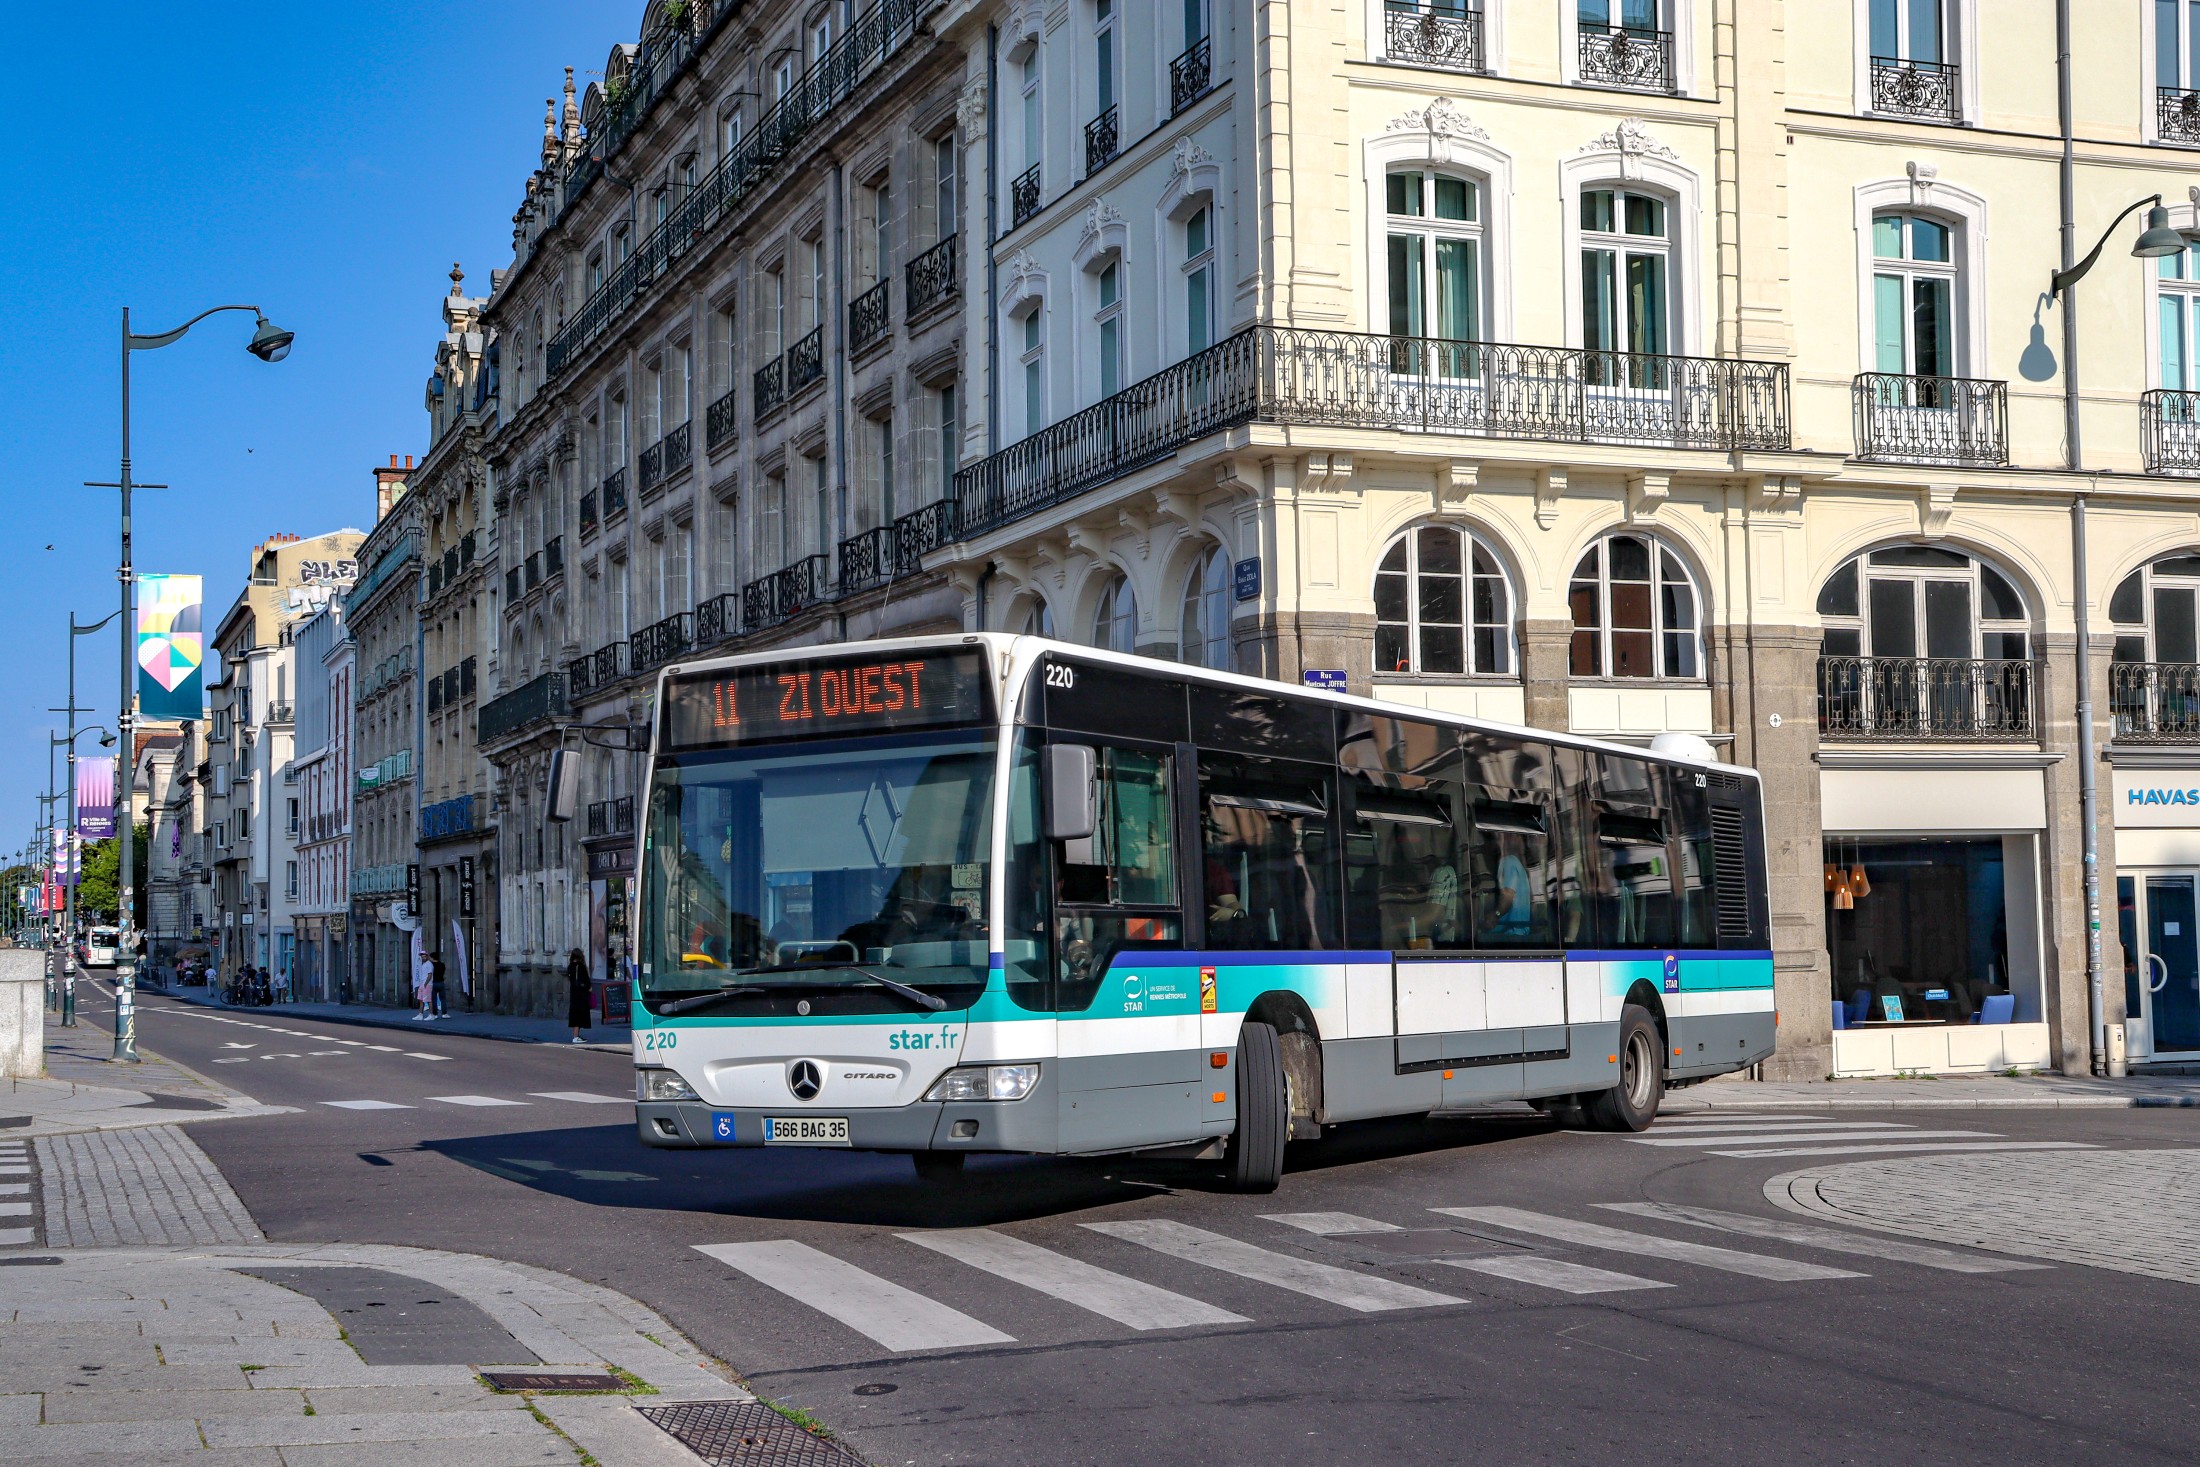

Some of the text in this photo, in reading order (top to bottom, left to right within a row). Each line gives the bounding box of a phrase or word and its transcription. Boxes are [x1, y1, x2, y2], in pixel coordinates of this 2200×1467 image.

[1046, 664, 1073, 688] 220
[1328, 680, 1346, 688] JOFFRE
[712, 662, 925, 726] 11 ZI OUEST
[1695, 773, 1706, 788] 220
[2128, 789, 2200, 805] HAVAS
[1665, 980, 1678, 989] STAR
[1124, 1002, 1143, 1012] STAR
[645, 1032, 677, 1050] 220
[889, 1025, 958, 1050] star.fr
[774, 1122, 798, 1138] 566
[801, 1122, 826, 1138] BAG
[829, 1122, 846, 1138] 35
